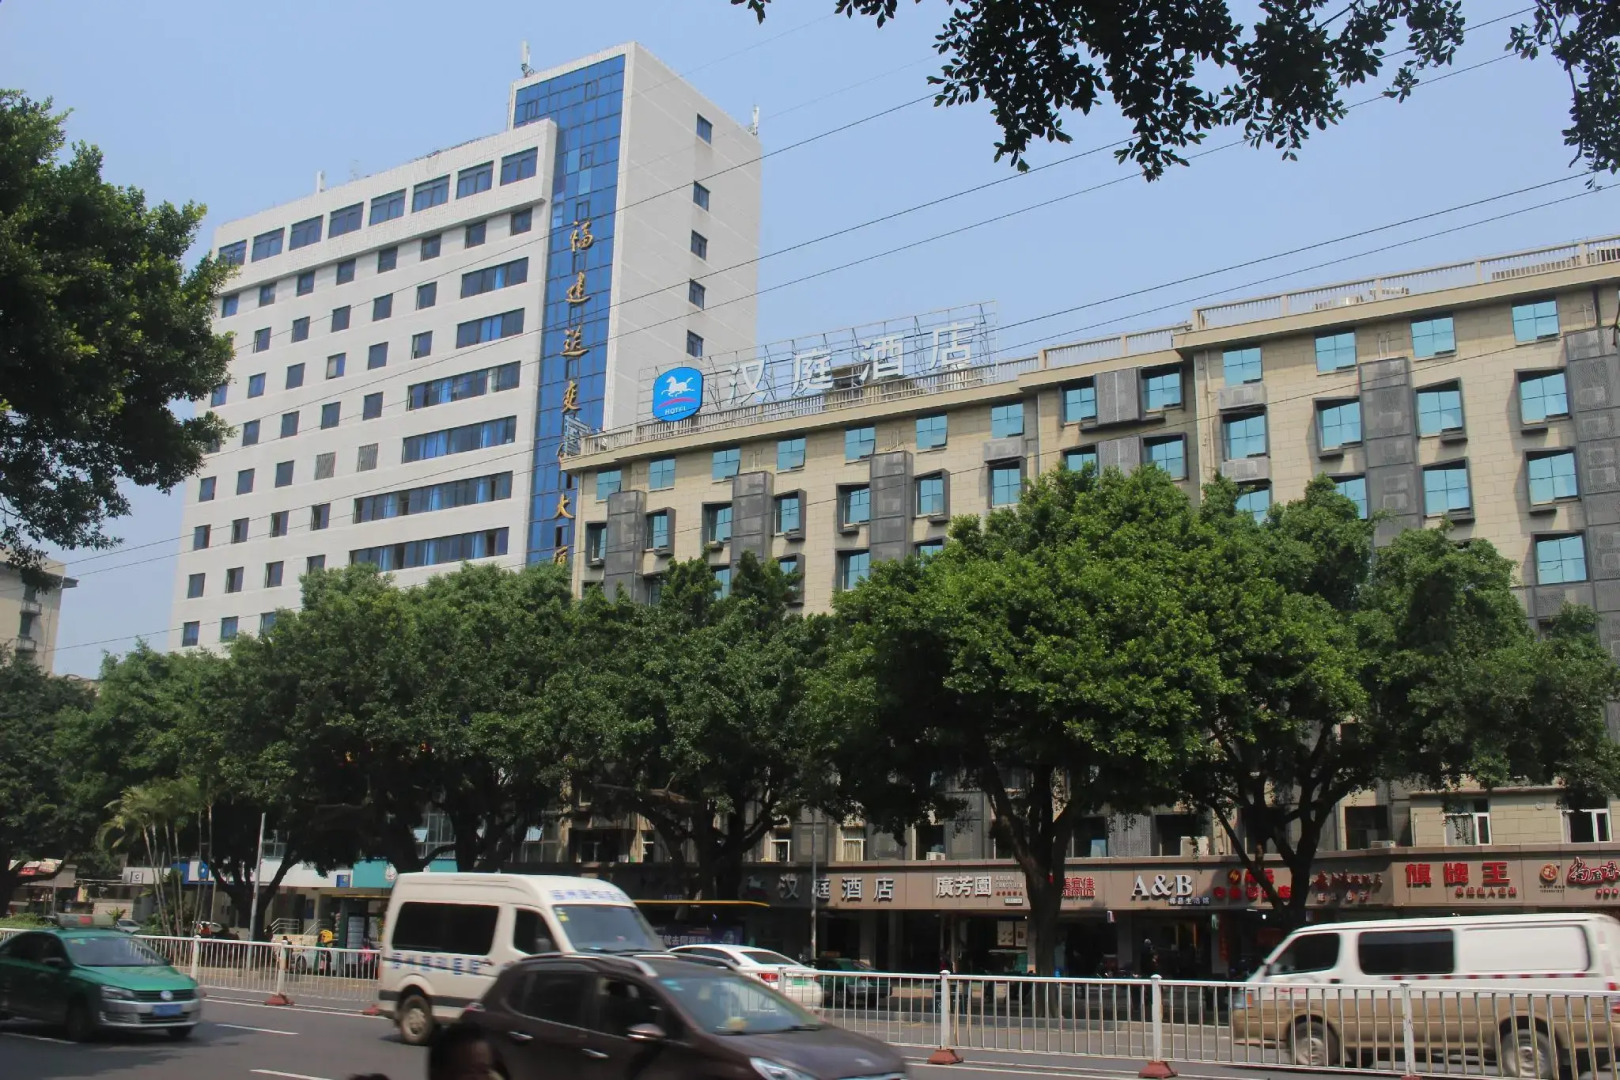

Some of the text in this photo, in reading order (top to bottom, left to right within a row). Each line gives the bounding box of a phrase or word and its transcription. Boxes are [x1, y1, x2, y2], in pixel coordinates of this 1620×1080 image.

[728, 322, 976, 407] 汉庭酒店
[664, 405, 687, 416] HOTEL
[1406, 861, 1510, 884] 旗牌王
[778, 873, 894, 901] 汉庭酒店
[1131, 874, 1193, 897] A&B
